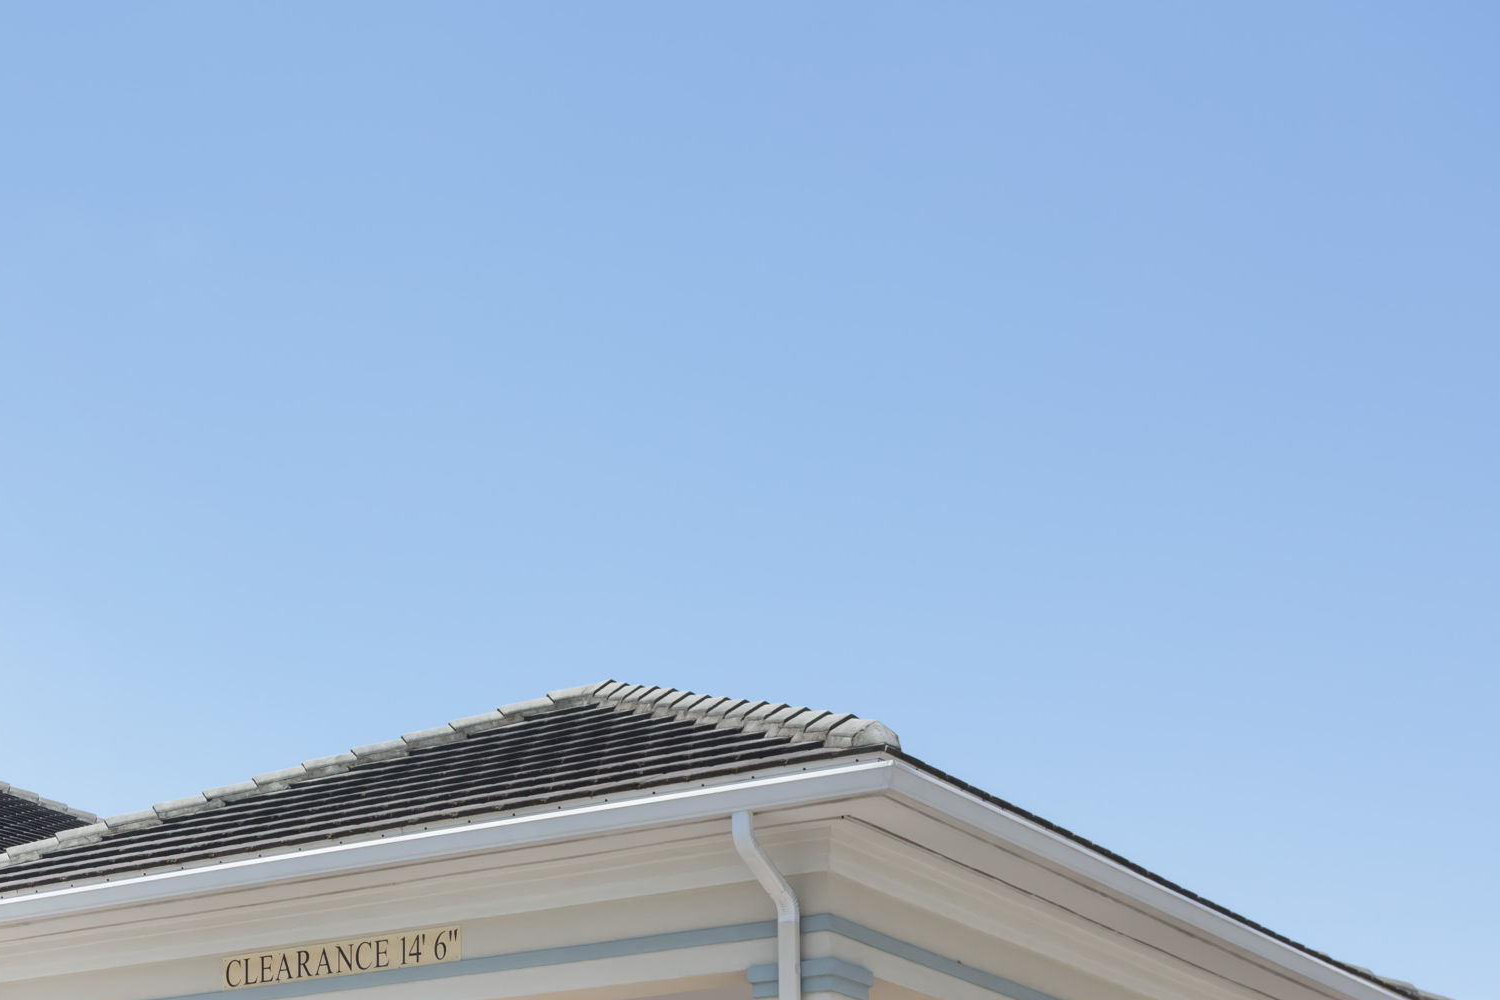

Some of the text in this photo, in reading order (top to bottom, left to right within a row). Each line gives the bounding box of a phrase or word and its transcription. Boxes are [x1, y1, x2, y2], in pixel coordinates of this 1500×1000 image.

[225, 928, 459, 988] CLEARANCE 14' 6"
